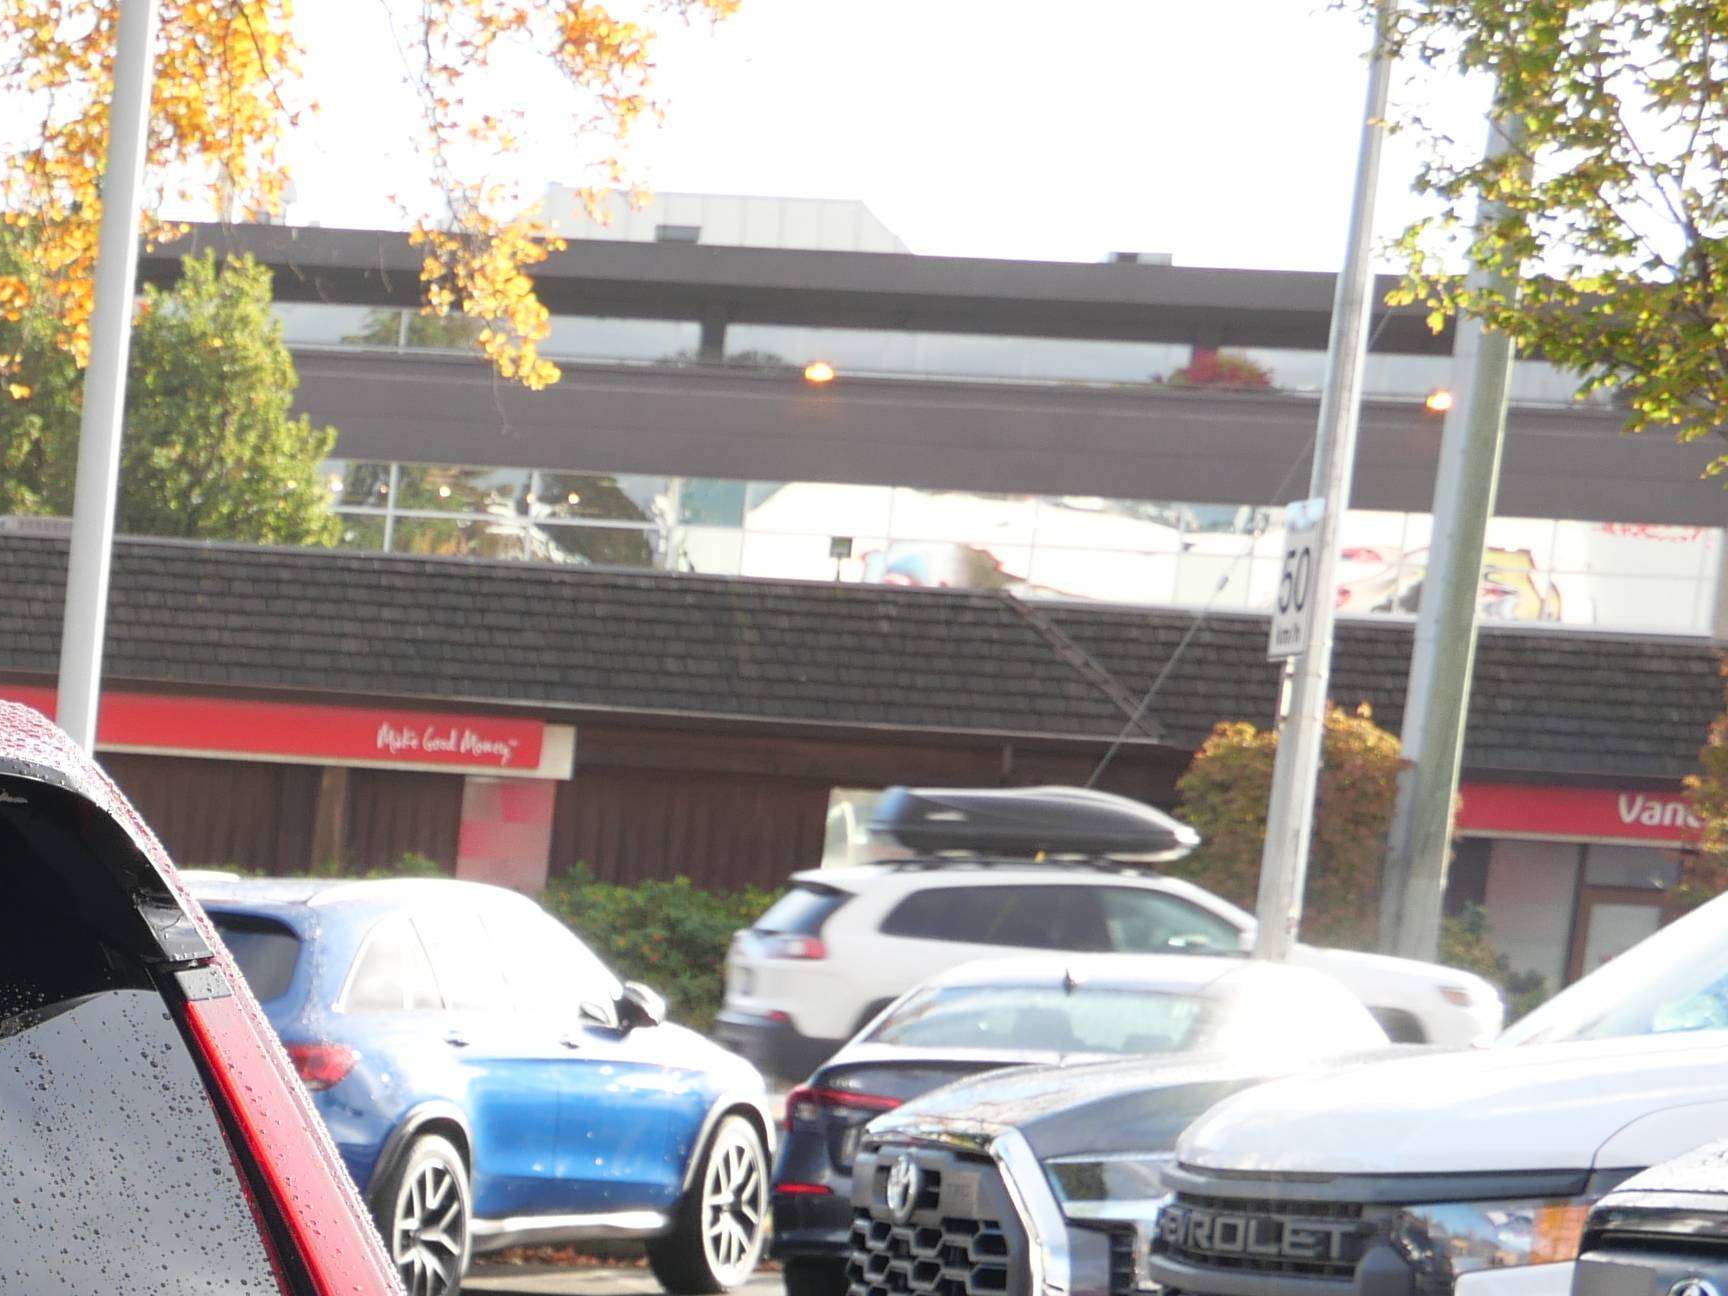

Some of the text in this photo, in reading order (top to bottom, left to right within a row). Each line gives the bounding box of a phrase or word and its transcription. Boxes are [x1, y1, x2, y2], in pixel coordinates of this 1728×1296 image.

[1278, 546, 1311, 615] 50
[377, 722, 420, 754] Make
[422, 725, 458, 752] Good
